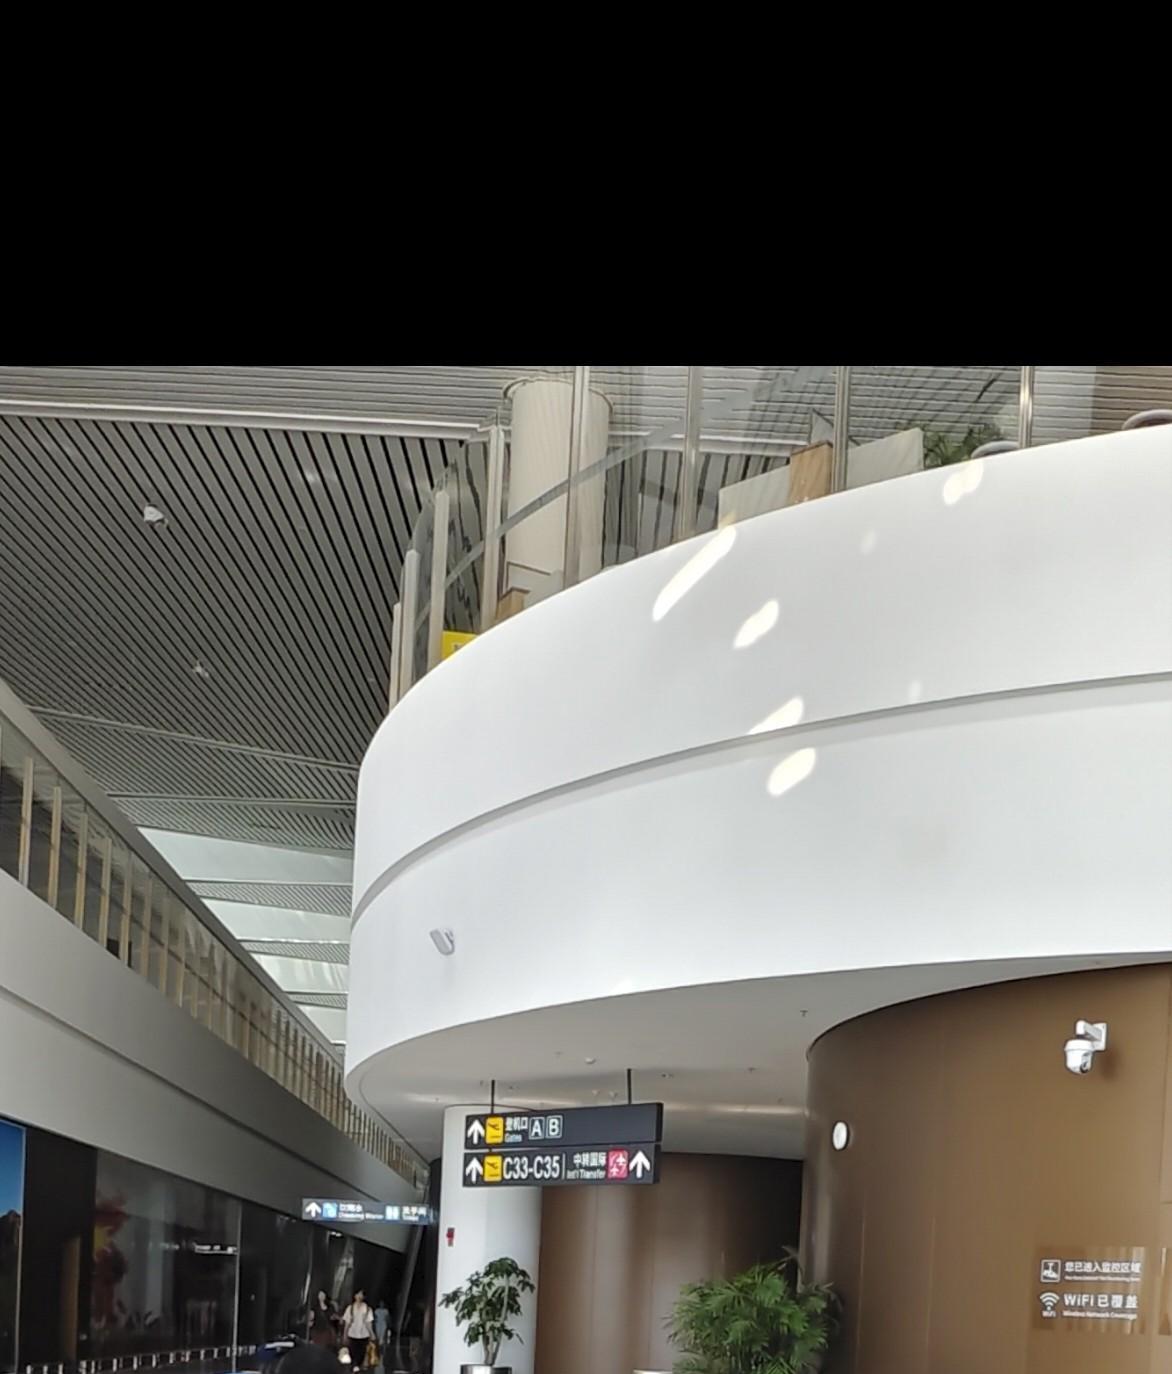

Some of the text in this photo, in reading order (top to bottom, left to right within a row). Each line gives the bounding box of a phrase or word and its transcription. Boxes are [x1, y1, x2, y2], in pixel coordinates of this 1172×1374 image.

[505, 1117, 560, 1137] 登机口 A B
[503, 1155, 560, 1179] C33-C35
[573, 1152, 607, 1168] 中转国际
[1064, 1261, 1141, 1273] 您已进入监控区域
